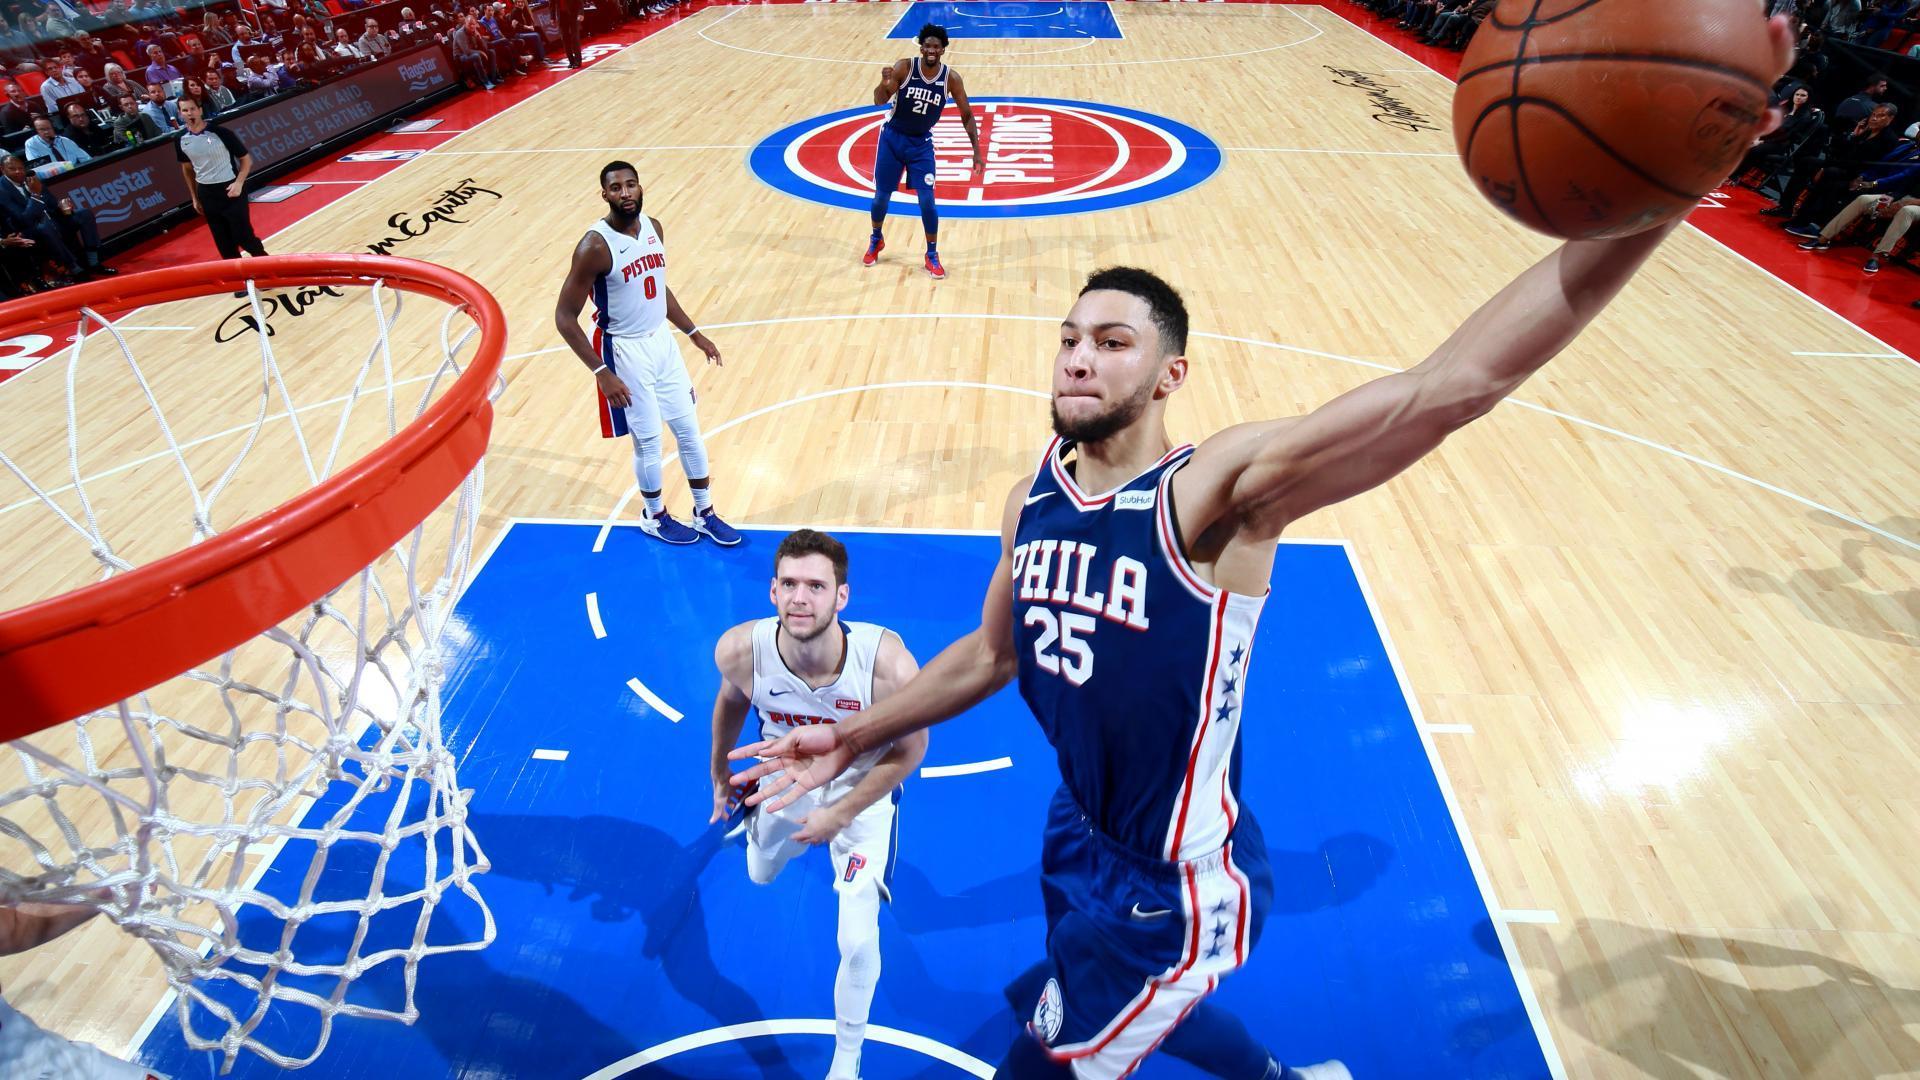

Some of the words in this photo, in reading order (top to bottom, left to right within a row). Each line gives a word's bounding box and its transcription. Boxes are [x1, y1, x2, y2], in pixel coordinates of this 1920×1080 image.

[233, 113, 291, 144] FICIAL
[290, 94, 335, 121] BANK
[335, 84, 363, 104] AND
[905, 86, 942, 107] PHILA
[912, 100, 929, 115] 21
[251, 126, 315, 162] RTGAGE
[315, 100, 375, 134] PARTNER
[983, 114, 1055, 184] PISTONS
[67, 167, 153, 211] Flagstar
[135, 190, 166, 211] Bank
[388, 178, 503, 236] Equity
[621, 253, 666, 283] PISTONS
[643, 275, 657, 300] 0
[1119, 496, 1152, 505] StubHub
[1013, 540, 1150, 632] PHILA
[1024, 605, 1096, 688] 25
